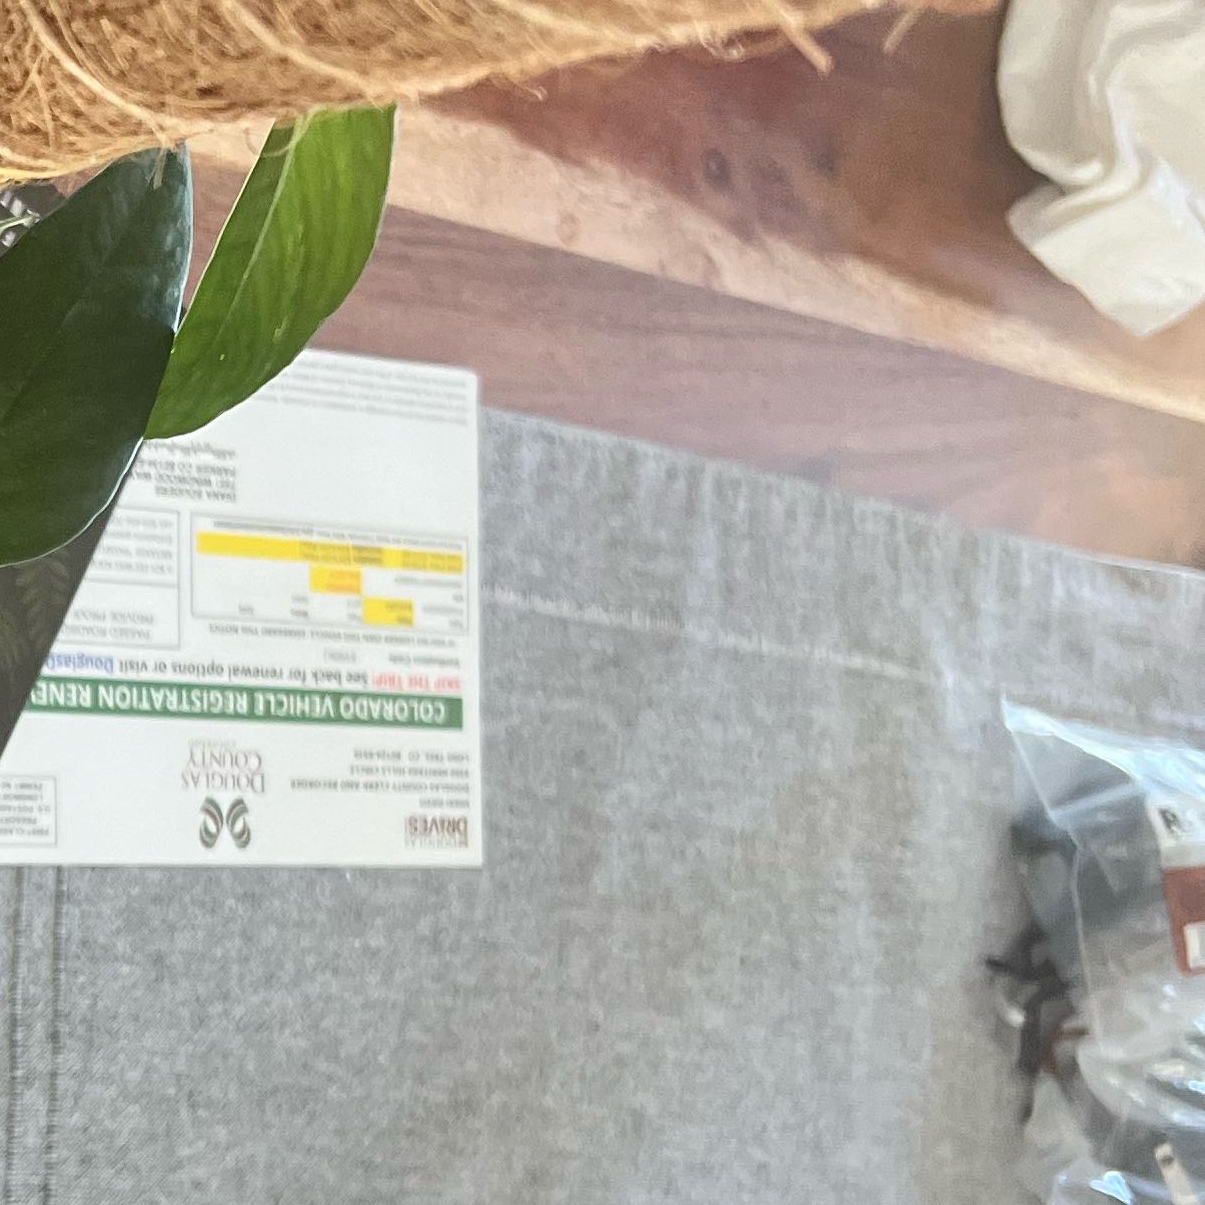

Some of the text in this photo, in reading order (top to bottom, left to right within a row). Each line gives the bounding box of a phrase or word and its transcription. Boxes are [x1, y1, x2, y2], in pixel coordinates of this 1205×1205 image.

[119, 659, 148, 673] visit
[153, 662, 166, 673] or
[171, 659, 224, 677] options
[228, 665, 283, 681] renewal
[288, 669, 306, 683] for
[311, 670, 342, 685] back
[347, 673, 367, 686] See
[409, 675, 430, 689] THE
[98, 684, 247, 715] REGISTRATION
[255, 693, 334, 717] VEHICLE
[340, 697, 445, 724] COLORADO
[186, 749, 262, 771] COUNTY
[181, 771, 265, 793] DOUGLAS
